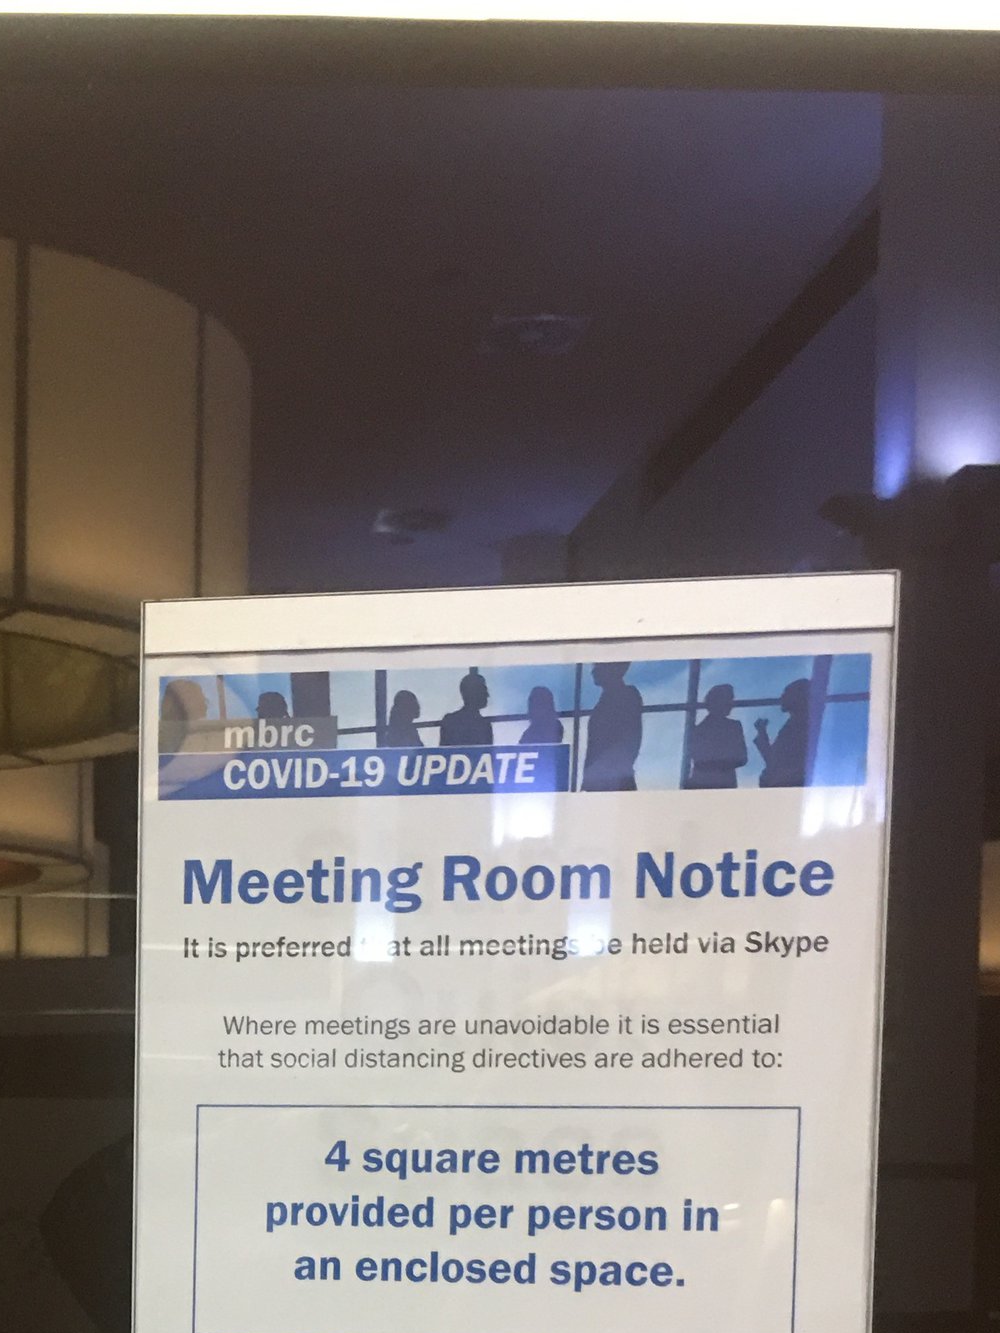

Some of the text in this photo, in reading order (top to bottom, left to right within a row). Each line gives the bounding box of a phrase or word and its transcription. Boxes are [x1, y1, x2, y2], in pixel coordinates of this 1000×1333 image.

[222, 716, 318, 750] mbrc
[222, 752, 539, 790] COVID-19 UPDATE
[183, 848, 835, 913] Meeting Room Notice
[183, 937, 200, 959] It
[208, 936, 228, 959] is
[235, 935, 351, 963] preferred
[419, 934, 450, 957] all
[459, 933, 580, 961] meetings
[631, 931, 689, 955] held
[697, 931, 736, 954] via
[744, 930, 830, 959] Skype
[223, 1013, 780, 1041] Where meetings are unavoidable it is essential
[217, 1047, 783, 1074] that social distancing directives are adhered to:
[324, 1139, 659, 1181] 4 square metres
[266, 1194, 719, 1237] provided per person in
[293, 1250, 685, 1293] an enclosed space.
